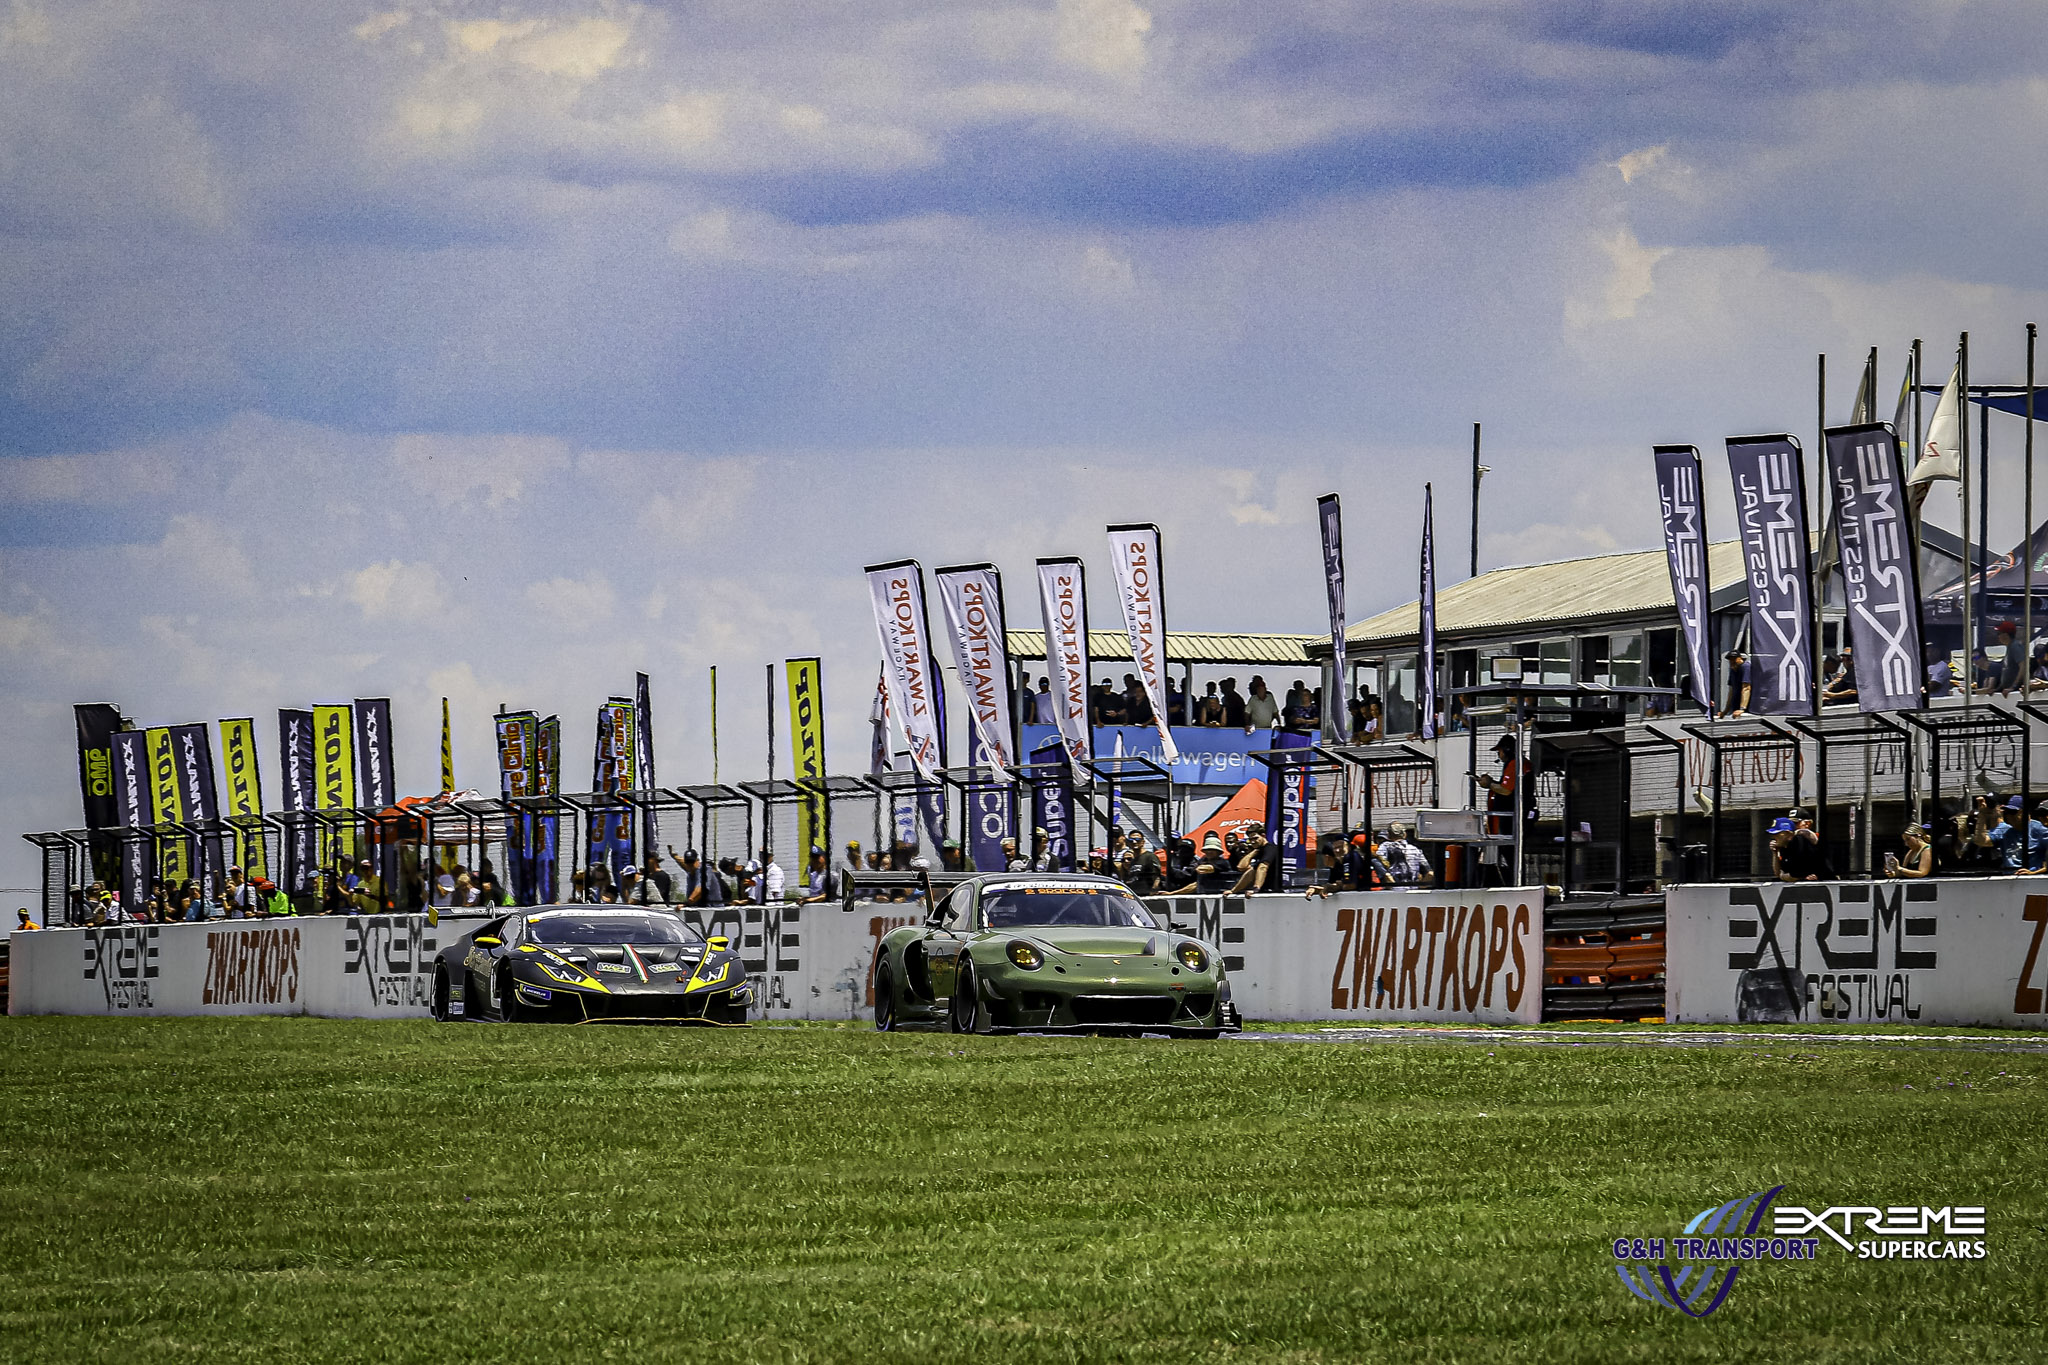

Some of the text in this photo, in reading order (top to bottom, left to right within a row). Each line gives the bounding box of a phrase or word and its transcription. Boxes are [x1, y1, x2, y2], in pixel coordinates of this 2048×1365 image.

[90, 748, 107, 796] OMP
[84, 927, 159, 1010] EXTREME
[203, 928, 301, 1005] ZWARTKOPS
[344, 917, 437, 1006] EXTREME
[1331, 904, 1530, 1013] ZWARTKOPS
[1729, 884, 1937, 1020] EXTREME
[1805, 974, 1922, 1021] FESTIVAL
